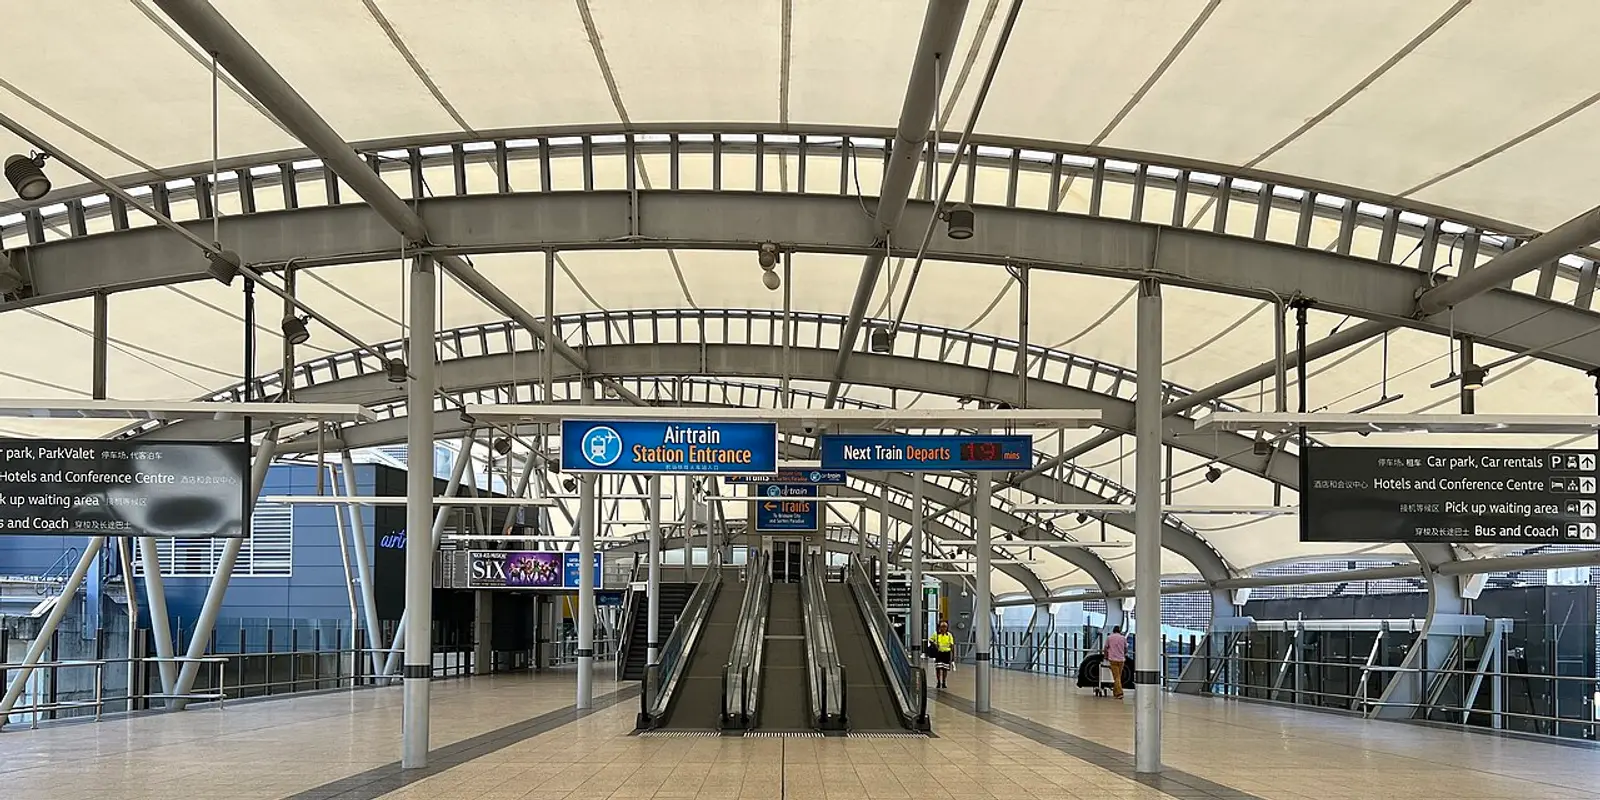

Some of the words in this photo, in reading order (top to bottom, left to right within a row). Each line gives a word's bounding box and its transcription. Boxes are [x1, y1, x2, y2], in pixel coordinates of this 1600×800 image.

[664, 425, 720, 444] Airtrain
[6, 446, 36, 461] park,
[38, 446, 95, 460] ParkValet
[633, 444, 684, 463] Station
[689, 445, 752, 464] Entrance
[843, 445, 871, 460] Next
[875, 445, 902, 460] Train
[906, 445, 950, 462] Departs
[1004, 451, 1020, 460] mins
[1427, 455, 1447, 468] Car
[1449, 455, 1478, 470] park,
[1481, 456, 1500, 468] Car
[1503, 456, 1544, 468] rentals
[1551, 456, 1561, 469] P
[0, 470, 37, 483] Hotels
[40, 470, 62, 483] and
[65, 470, 131, 484] Conference
[135, 472, 175, 484] Centre
[1373, 477, 1412, 490] Hotels
[1414, 477, 1437, 490] and
[1439, 477, 1504, 491] Conference
[1506, 479, 1544, 491] Centre
[10, 496, 25, 508] up
[28, 493, 70, 509] waiting
[74, 497, 100, 506] area
[1445, 501, 1468, 513] Pick
[1471, 504, 1487, 516] up
[1489, 501, 1532, 517] waiting
[1534, 504, 1559, 514] area
[7, 517, 30, 529] and
[33, 517, 69, 530] Coach
[1474, 524, 1497, 536] Bus
[1499, 524, 1521, 537] and
[1524, 524, 1559, 538] Coach
